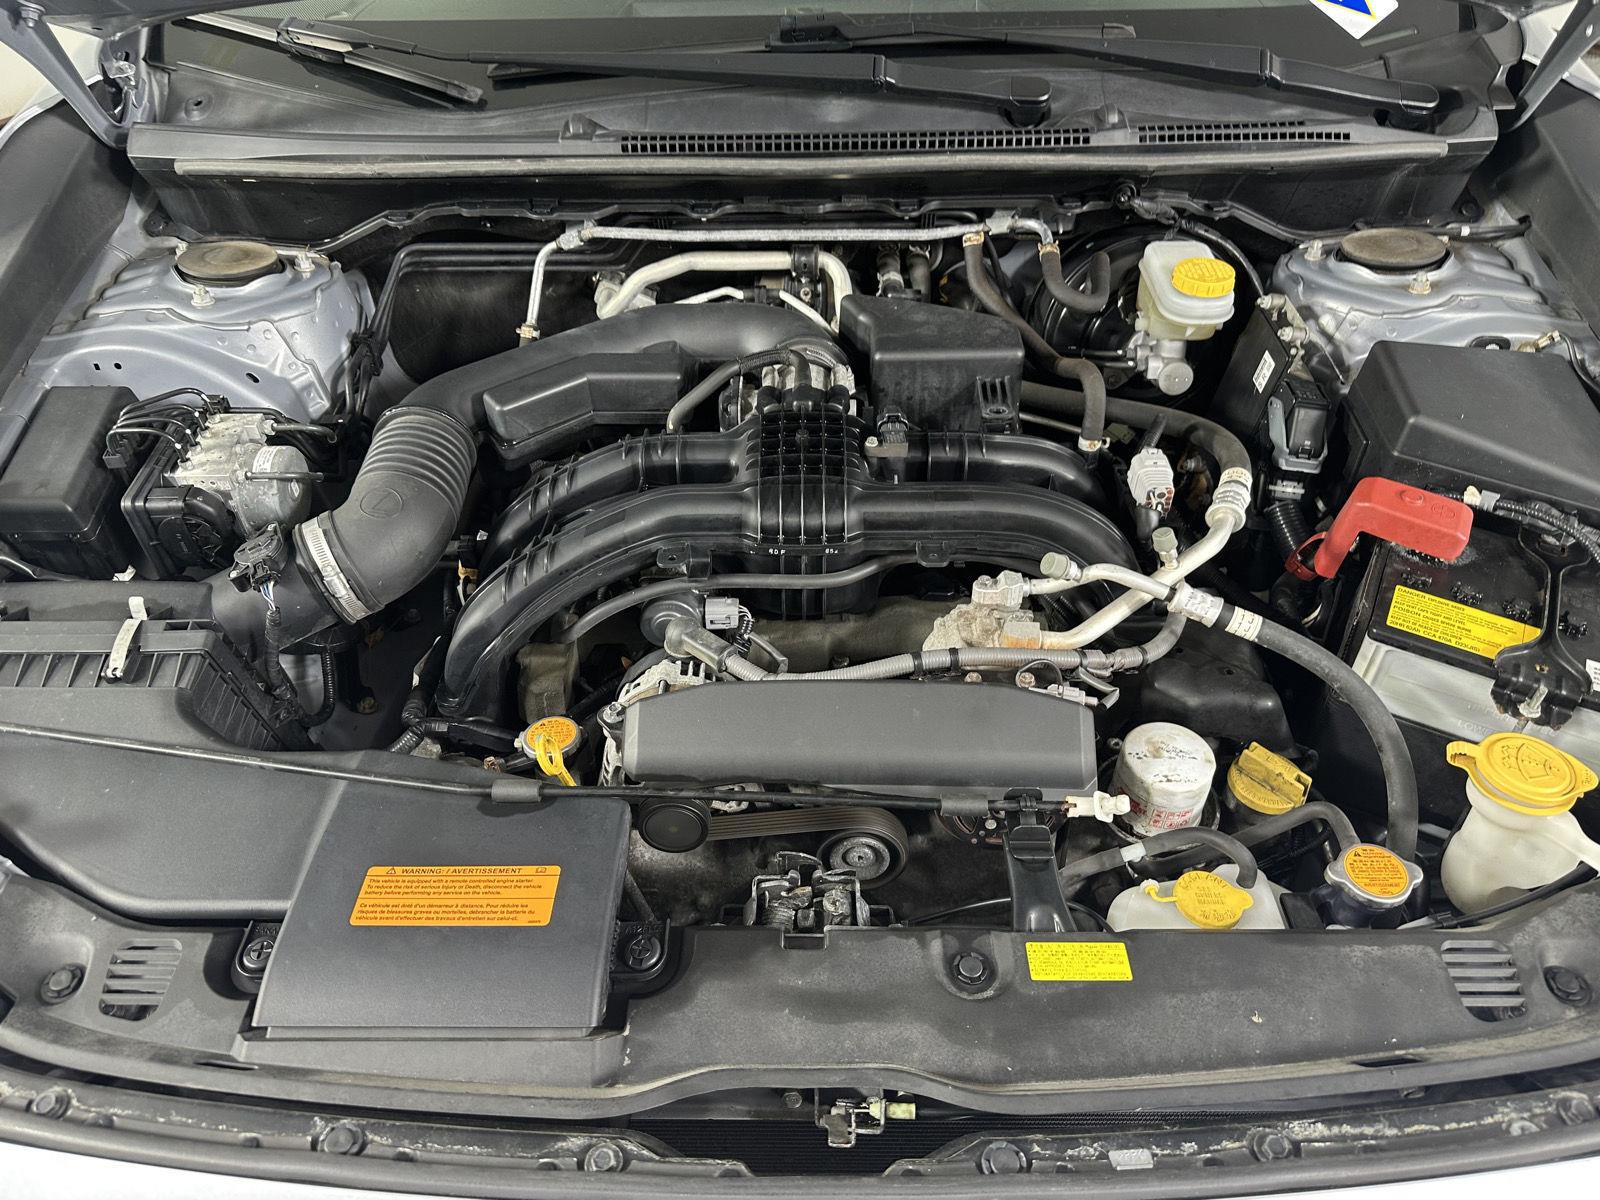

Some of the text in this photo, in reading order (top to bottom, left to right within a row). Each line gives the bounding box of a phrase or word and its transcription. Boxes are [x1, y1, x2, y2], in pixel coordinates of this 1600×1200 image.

[1397, 587, 1426, 600] DANGER
[1393, 605, 1421, 617] POISON
[1422, 630, 1437, 638] CCA
